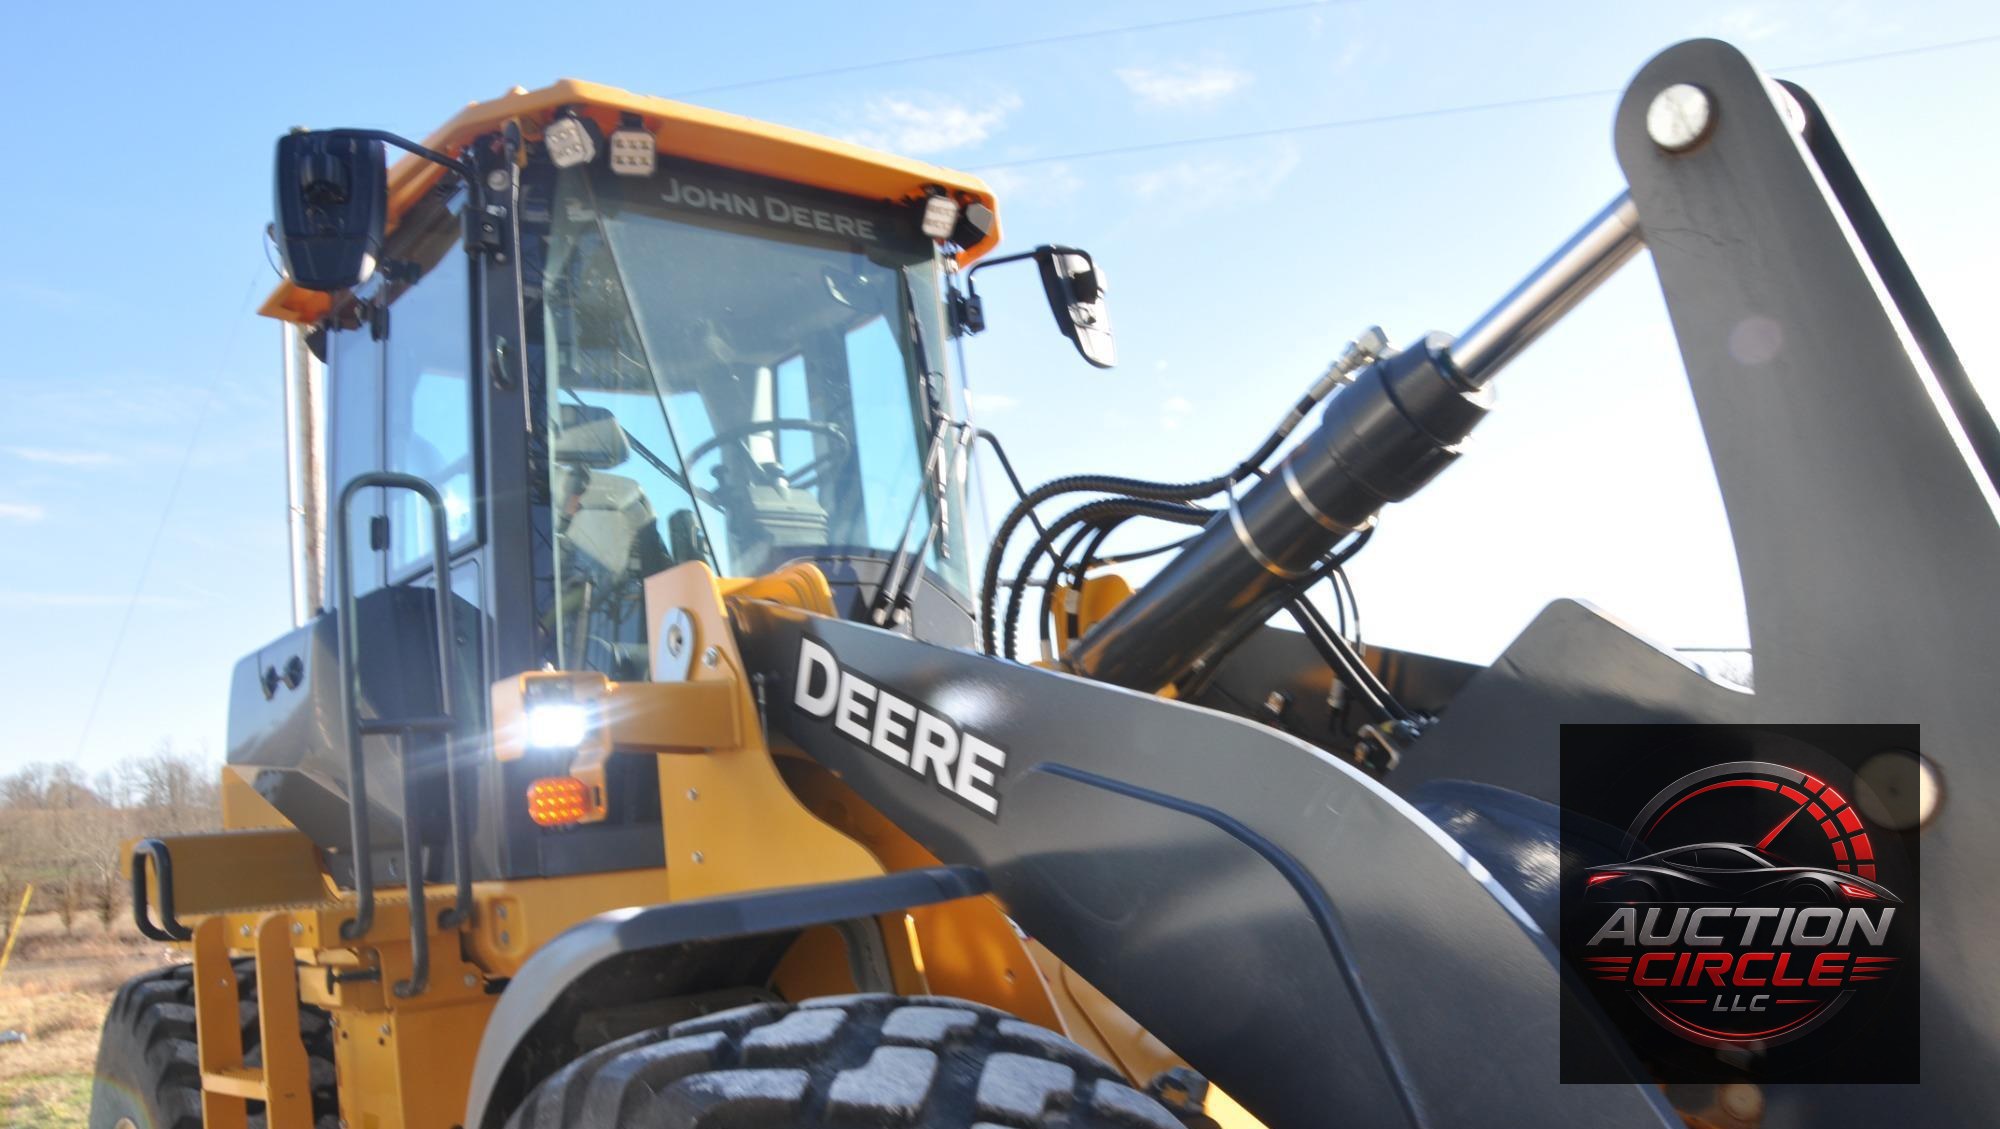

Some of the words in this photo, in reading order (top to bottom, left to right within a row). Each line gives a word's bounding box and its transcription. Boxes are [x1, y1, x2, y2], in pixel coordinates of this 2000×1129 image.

[661, 177, 760, 219] JOHN
[763, 195, 878, 240] DEERE
[794, 637, 1007, 816] DEERE
